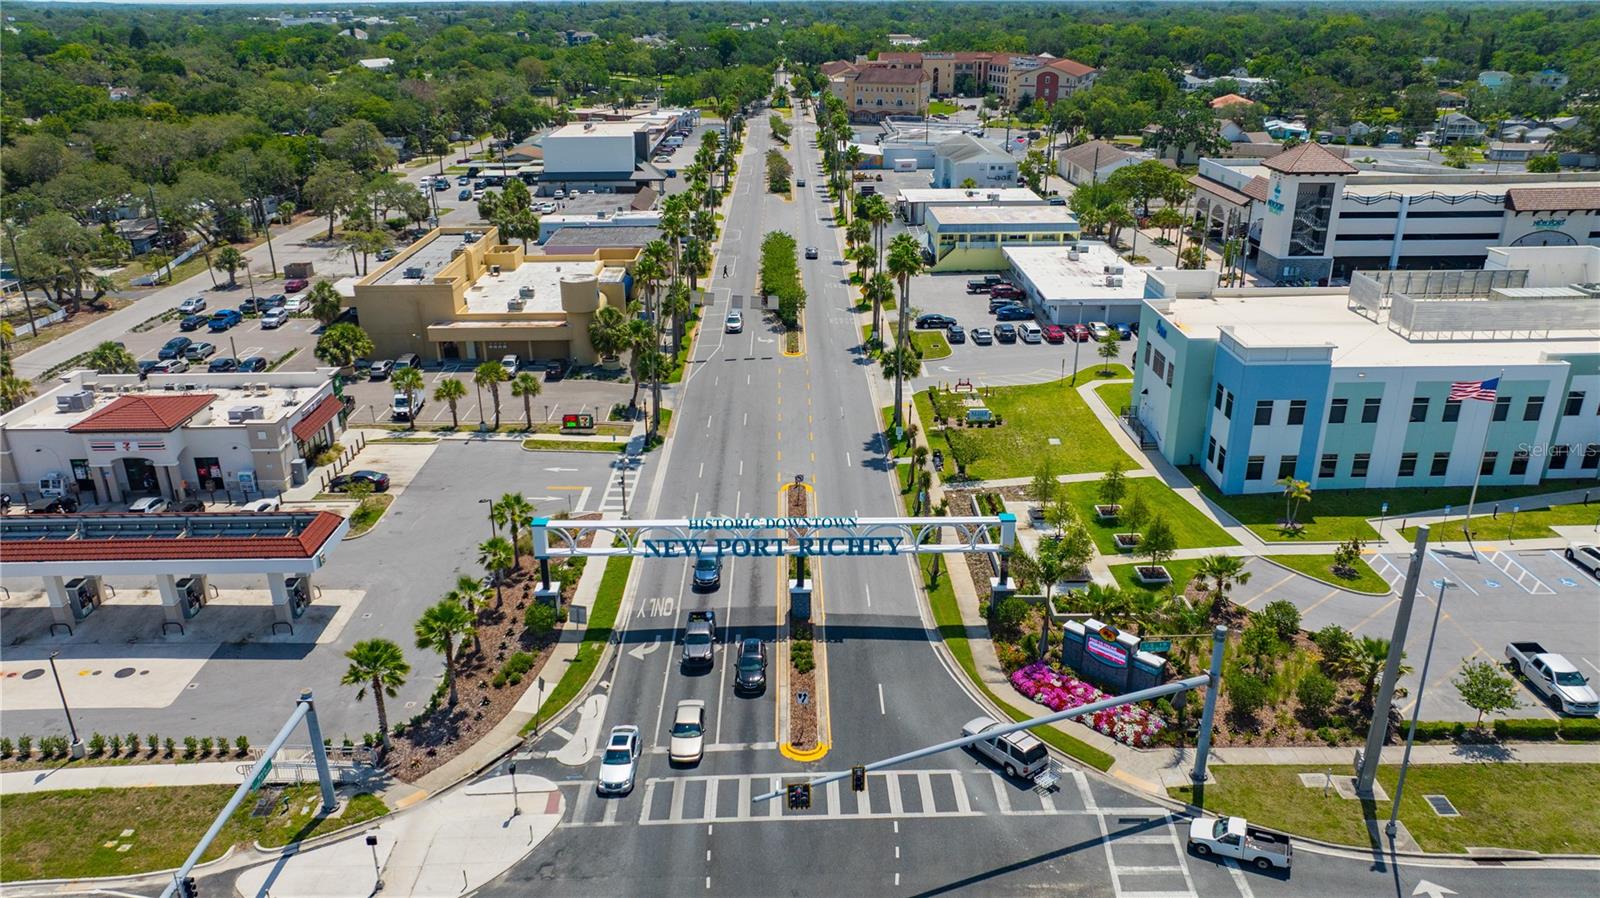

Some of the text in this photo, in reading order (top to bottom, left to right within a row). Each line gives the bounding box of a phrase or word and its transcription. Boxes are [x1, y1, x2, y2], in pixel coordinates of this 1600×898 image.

[688, 517, 858, 530] HISTORIC DOWNTOWN
[642, 536, 904, 559] NEW PORT RICHEY
[636, 596, 674, 618] ONLY
